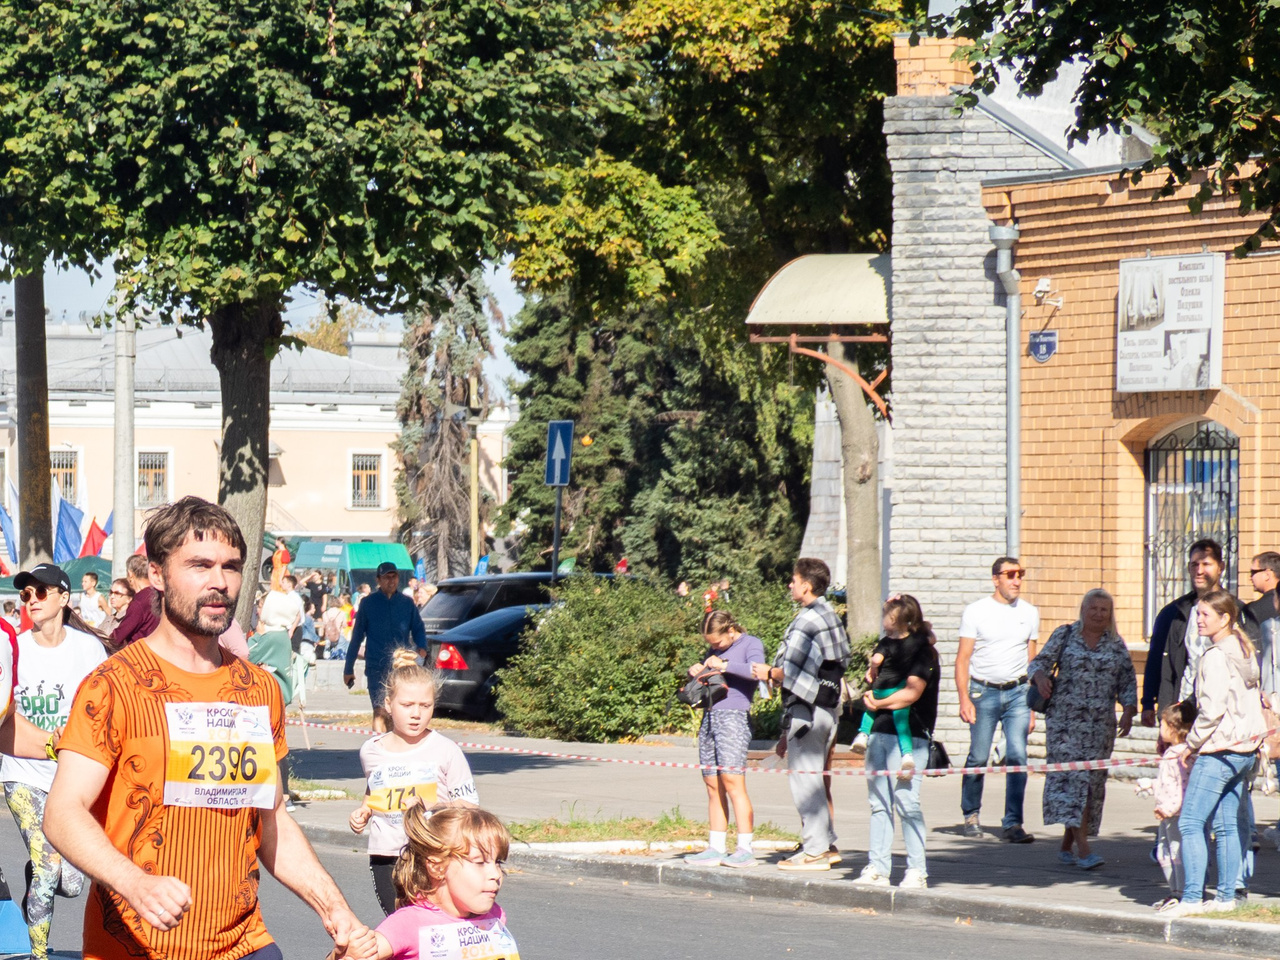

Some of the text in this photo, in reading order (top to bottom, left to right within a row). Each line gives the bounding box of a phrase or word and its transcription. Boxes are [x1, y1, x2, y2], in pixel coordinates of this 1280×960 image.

[21, 693, 59, 715] PRO
[187, 745, 258, 781] 2396
[459, 934, 491, 947] НАЦИИ
